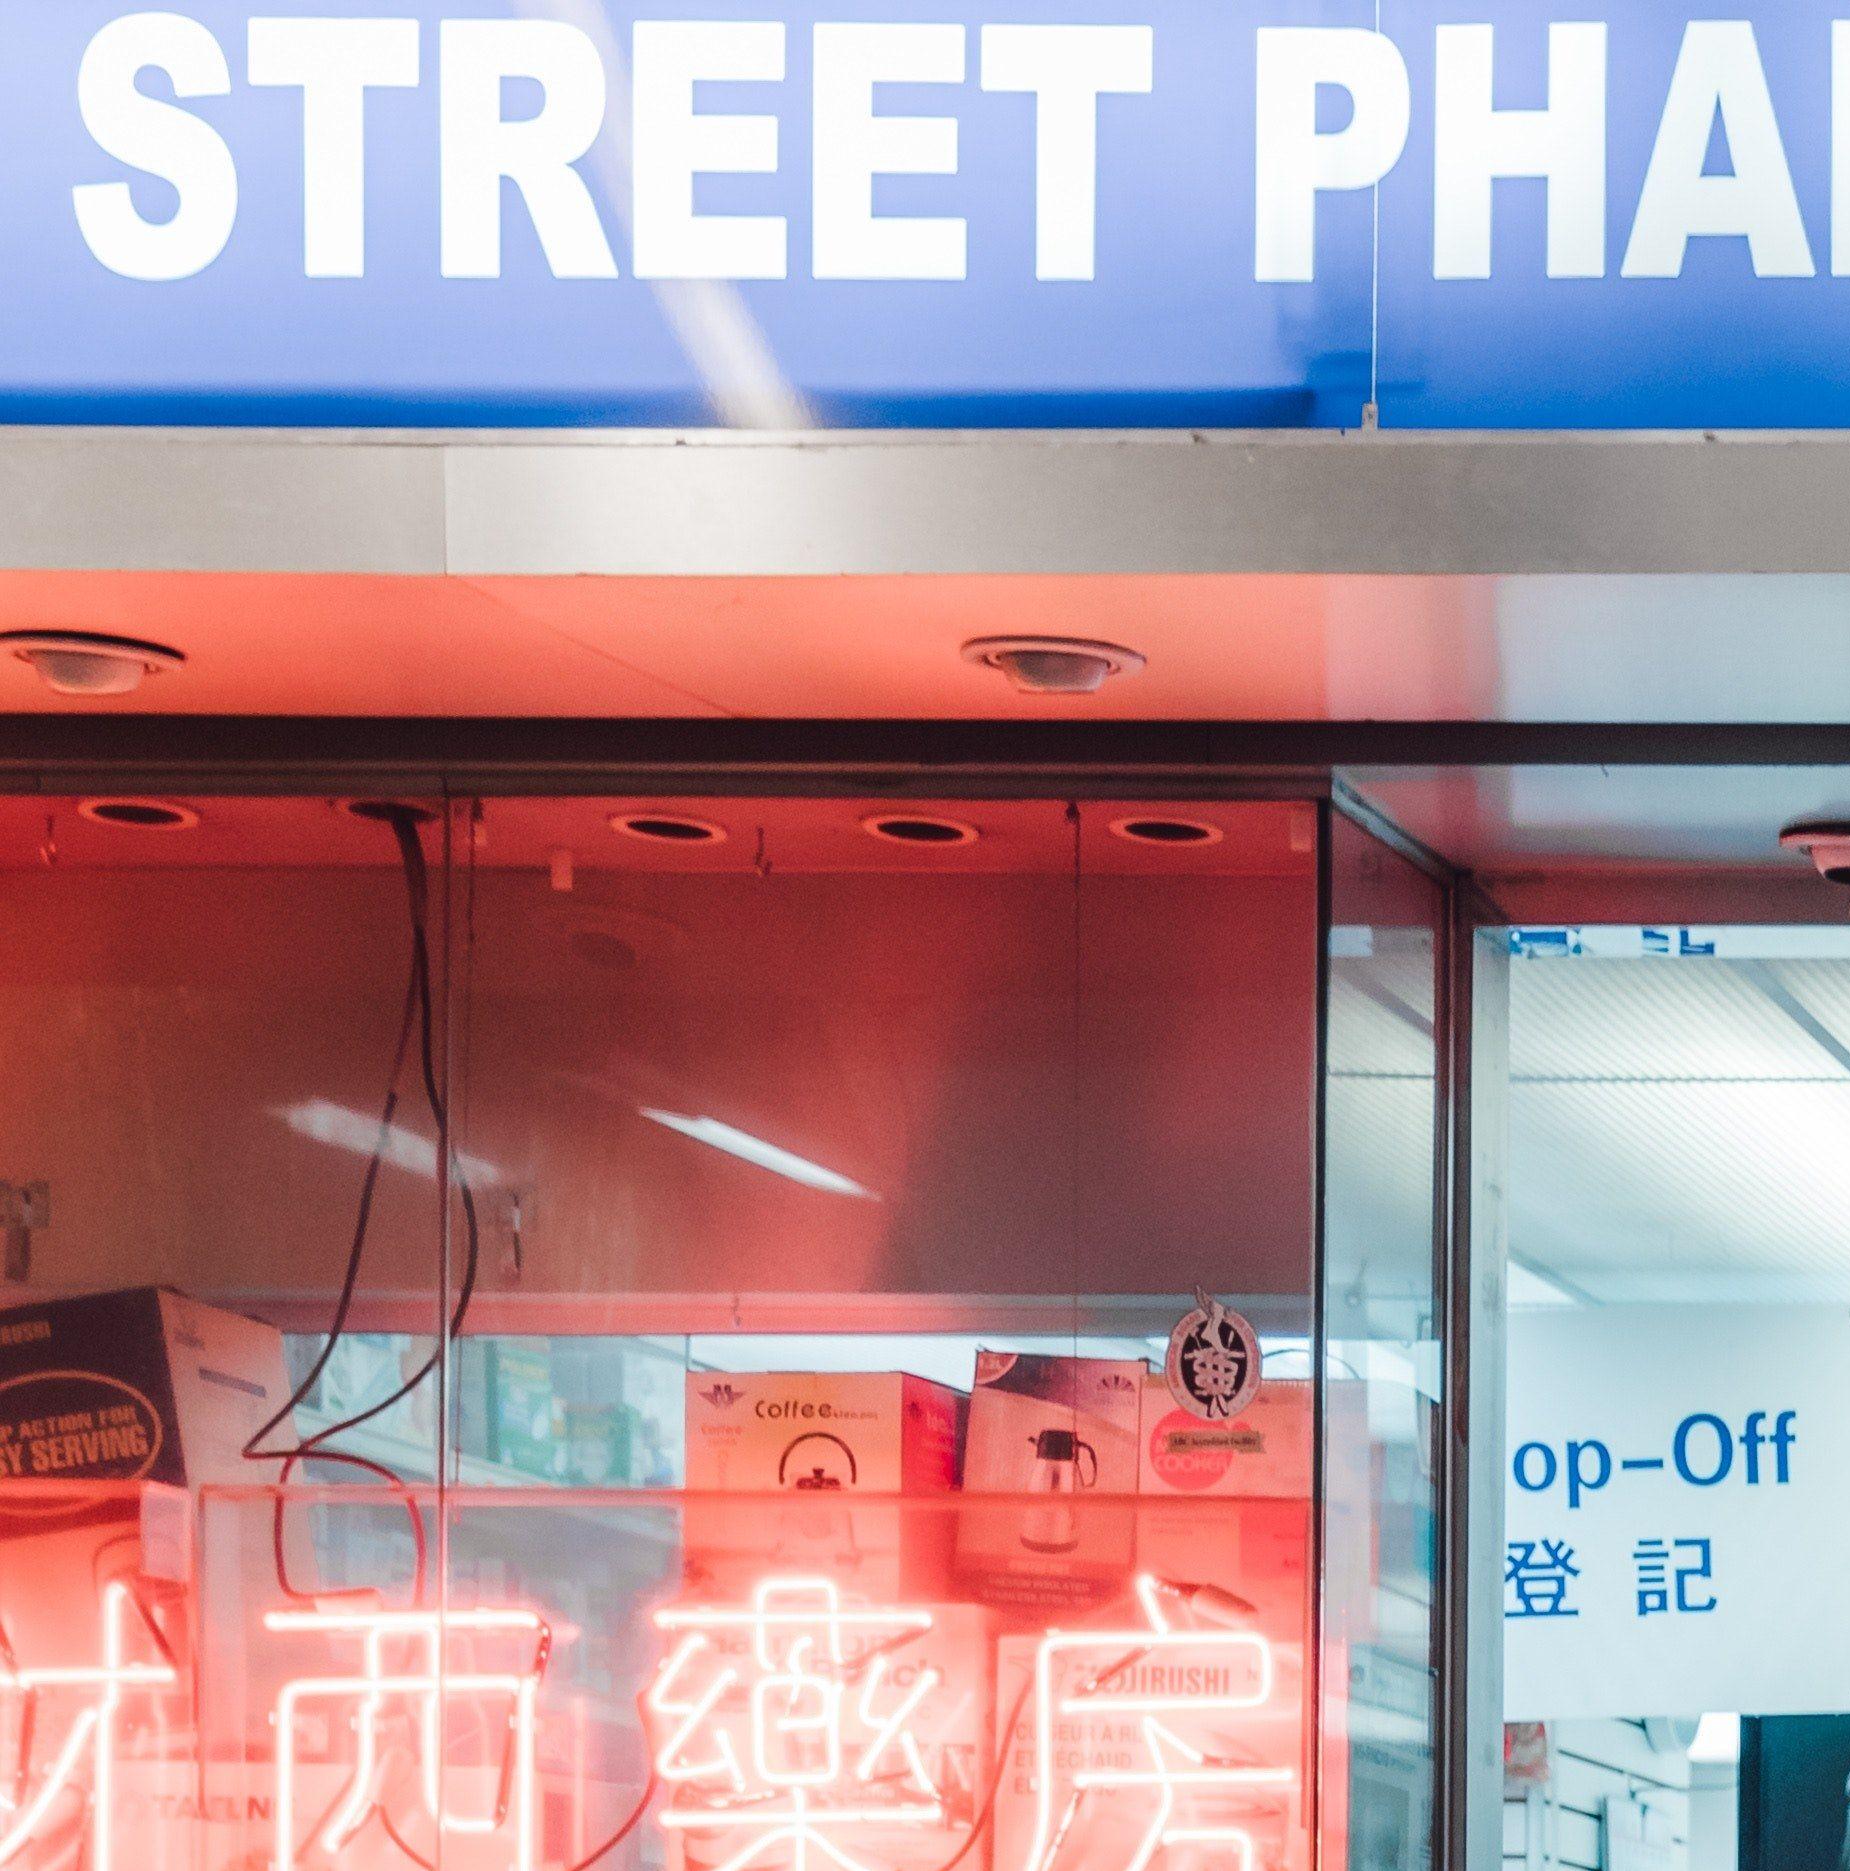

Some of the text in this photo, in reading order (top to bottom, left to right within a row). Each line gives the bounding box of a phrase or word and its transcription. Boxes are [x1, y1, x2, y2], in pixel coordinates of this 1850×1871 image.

[72, 14, 1150, 282] STREET
[756, 1400, 833, 1420] Coffee
[30, 1424, 149, 1471] SERVING
[1504, 1537, 1719, 1618] 登記
